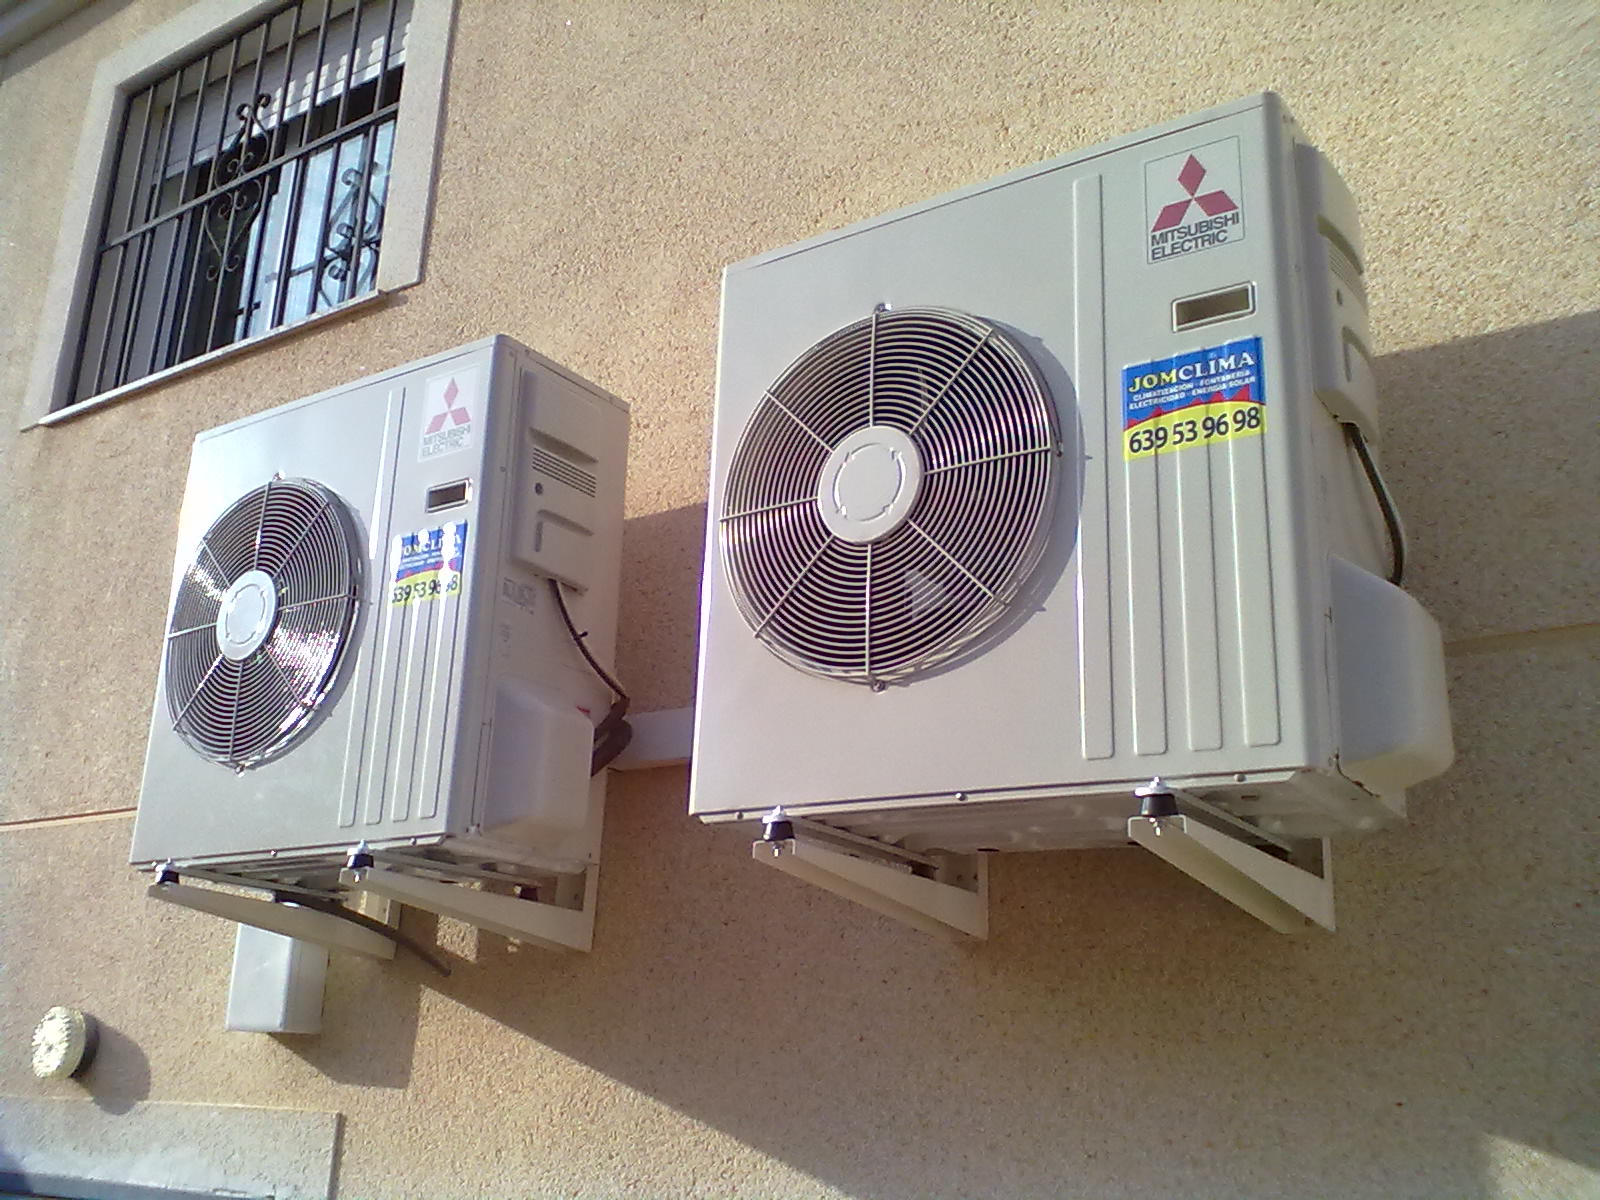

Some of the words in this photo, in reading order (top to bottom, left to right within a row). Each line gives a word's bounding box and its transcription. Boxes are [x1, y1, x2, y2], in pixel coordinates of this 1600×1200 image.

[1151, 211, 1240, 247] MITSUBISHI
[1151, 229, 1228, 261] ELECTRIC
[1128, 352, 1255, 393] JOMCLIMA
[422, 436, 464, 456] ELECTRIC
[1129, 426, 1168, 454] 639
[1172, 420, 1198, 445] 53
[1202, 413, 1229, 439] 96
[1233, 406, 1260, 432] 98
